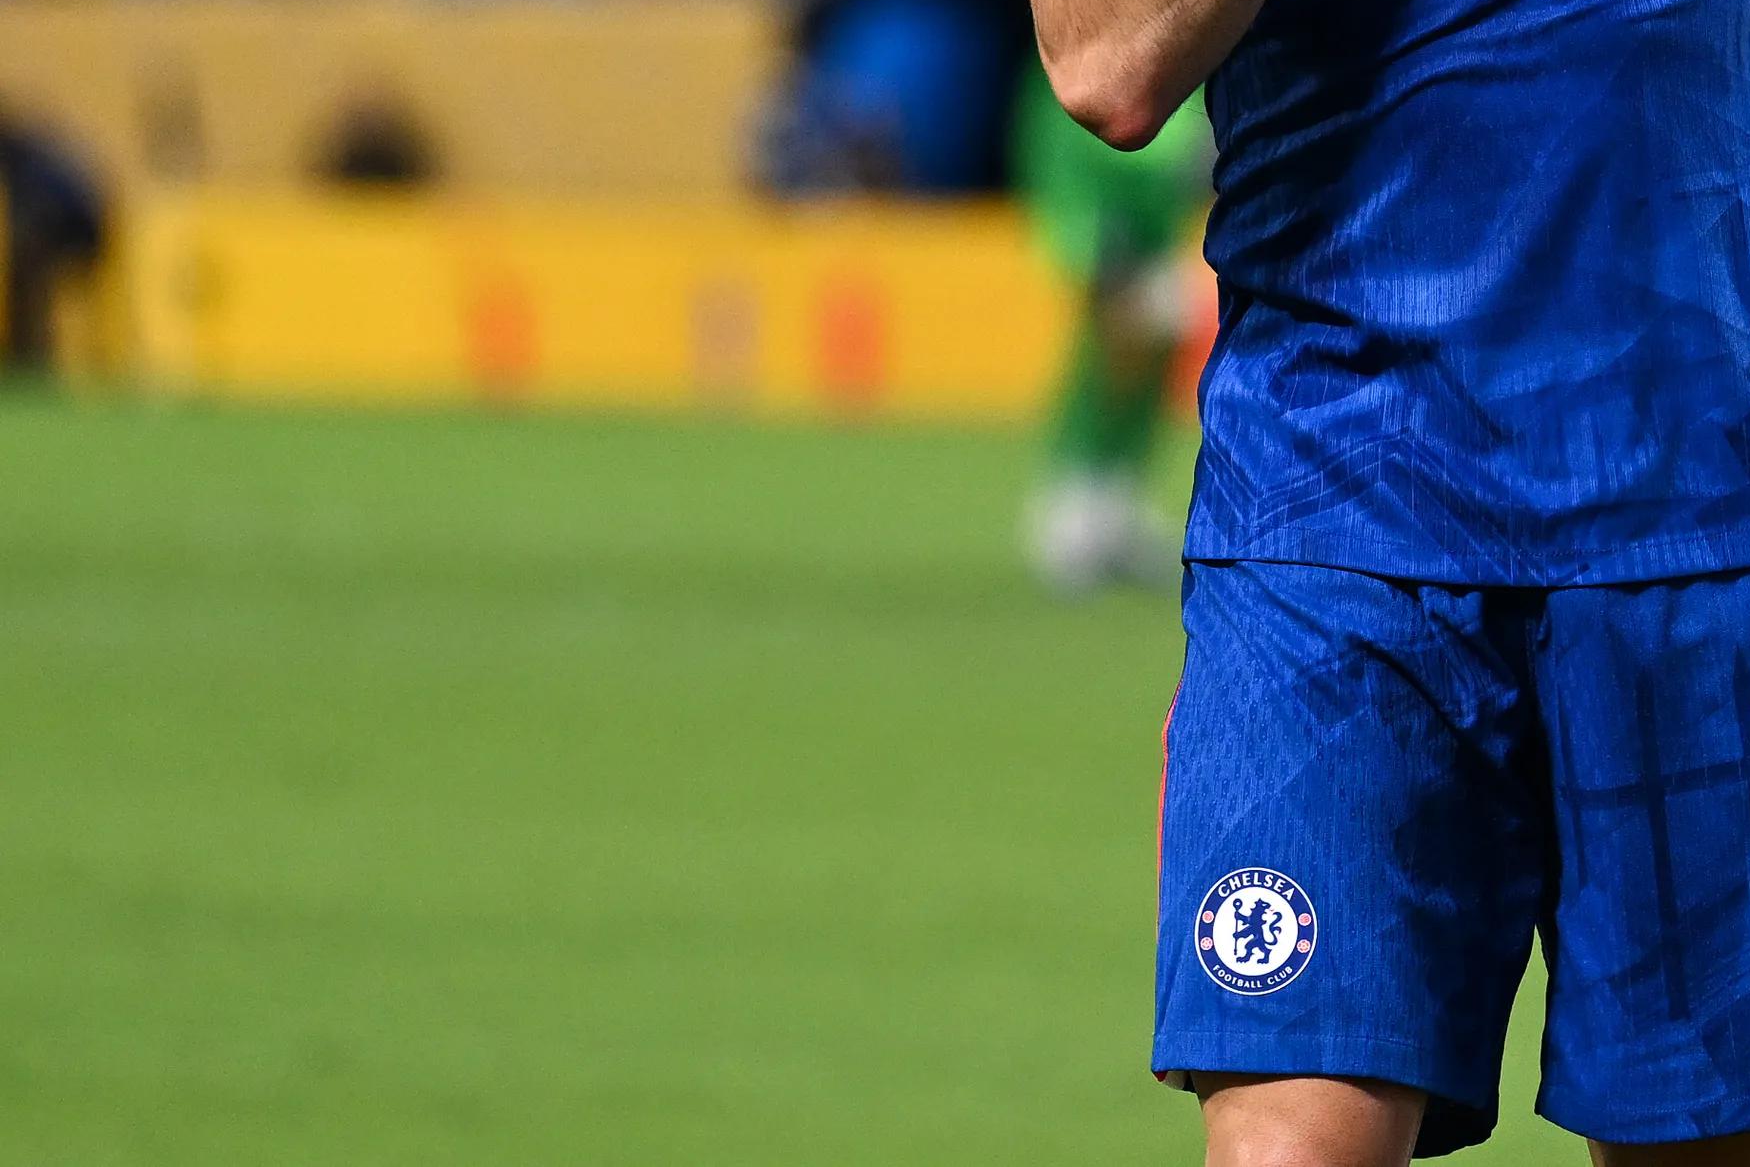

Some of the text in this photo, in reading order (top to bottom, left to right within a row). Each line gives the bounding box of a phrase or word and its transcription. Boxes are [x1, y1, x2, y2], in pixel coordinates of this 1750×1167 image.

[1217, 872, 1295, 901] CHELSEA
[1212, 964, 1293, 989] FOOTBALL CLUB
